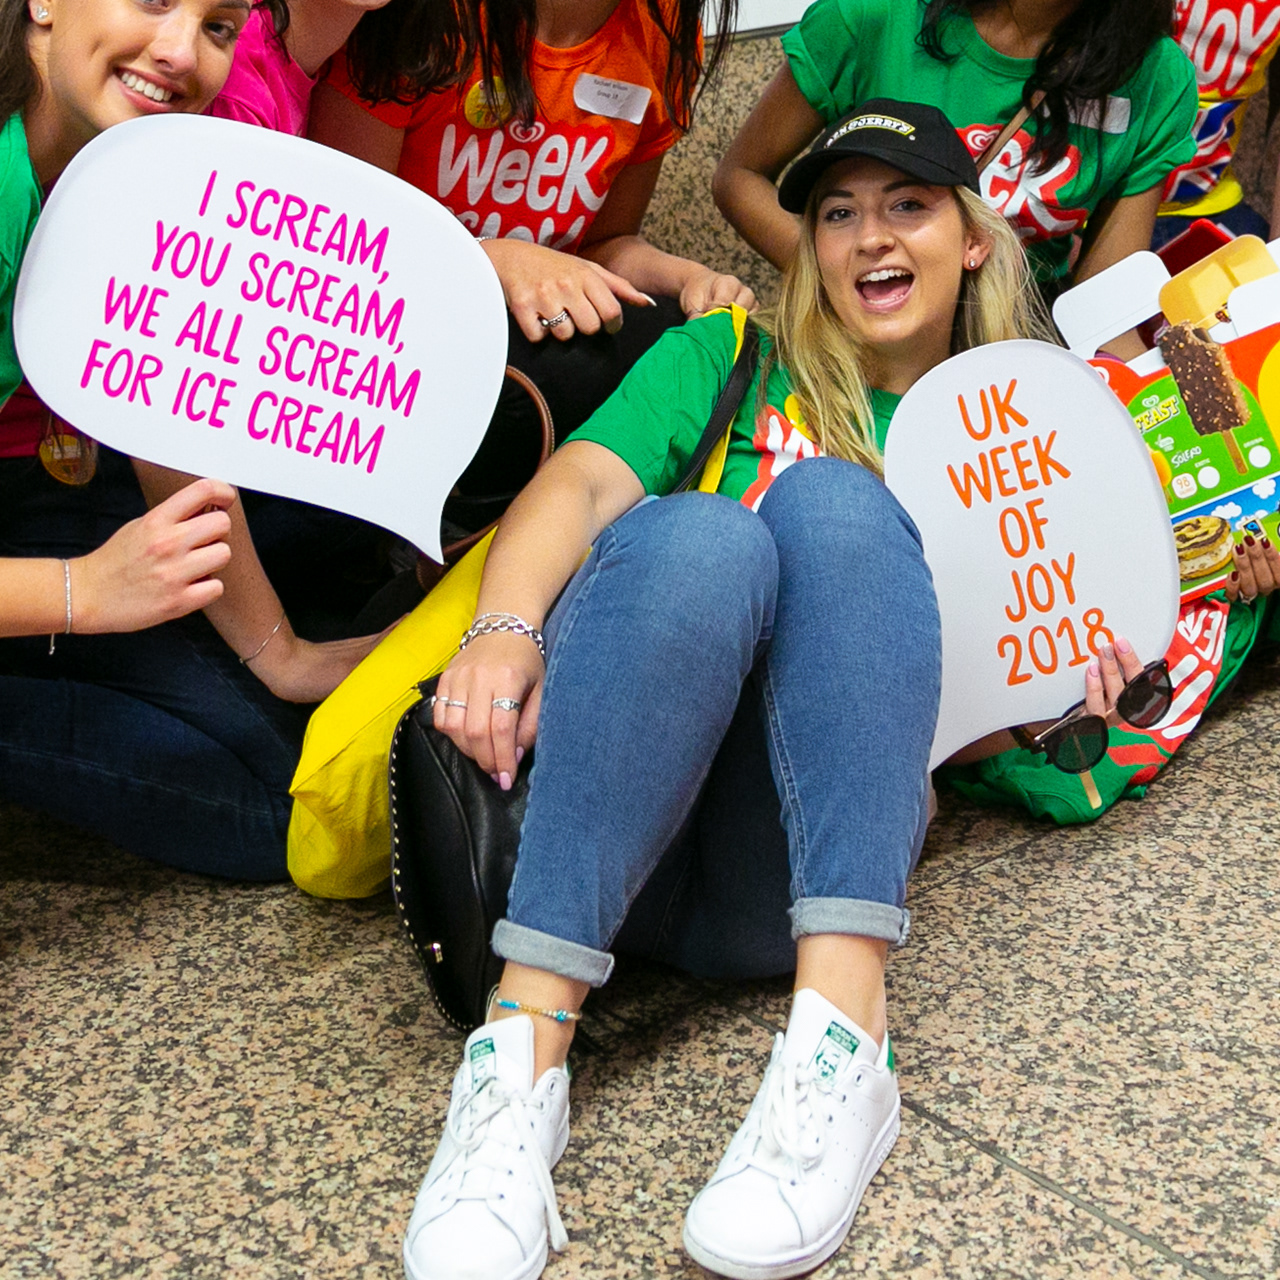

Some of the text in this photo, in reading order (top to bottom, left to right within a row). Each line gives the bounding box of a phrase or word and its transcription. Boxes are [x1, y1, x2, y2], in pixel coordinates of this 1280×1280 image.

[857, 116, 911, 134] JERRY'S
[199, 170, 218, 217] I
[226, 180, 390, 285] SCREAM,
[151, 220, 406, 354] YOU SCREAM,
[104, 276, 422, 417] WE ALL SCREAM
[80, 339, 386, 474] FOR ICE CREAM
[957, 378, 1030, 442] UK
[946, 429, 1072, 509] WEEK
[998, 497, 1049, 559] OF
[1004, 552, 1076, 623] JOY
[996, 607, 1116, 687] 2018
